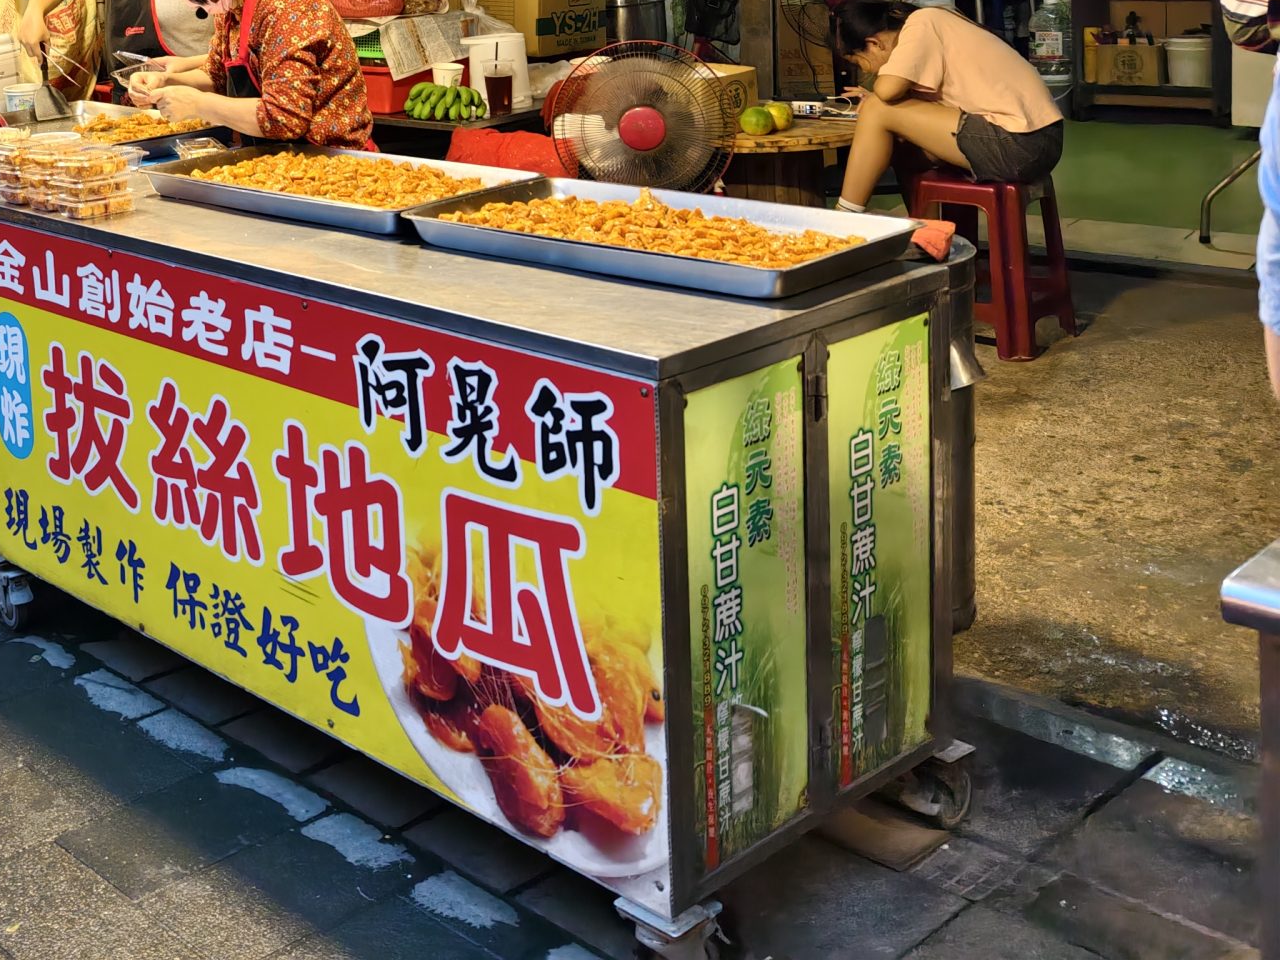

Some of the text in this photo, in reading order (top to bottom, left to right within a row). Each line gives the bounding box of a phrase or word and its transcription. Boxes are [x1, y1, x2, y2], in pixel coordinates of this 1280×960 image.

[744, 398, 773, 548] 綠元素
[877, 350, 903, 489] 綠元素
[4, 487, 361, 717] 現場製作 保證好吃
[42, 340, 602, 718] 拔絲地瓜
[711, 483, 744, 697] 白甘蔗汁
[849, 429, 877, 625] 白甘蔗汁
